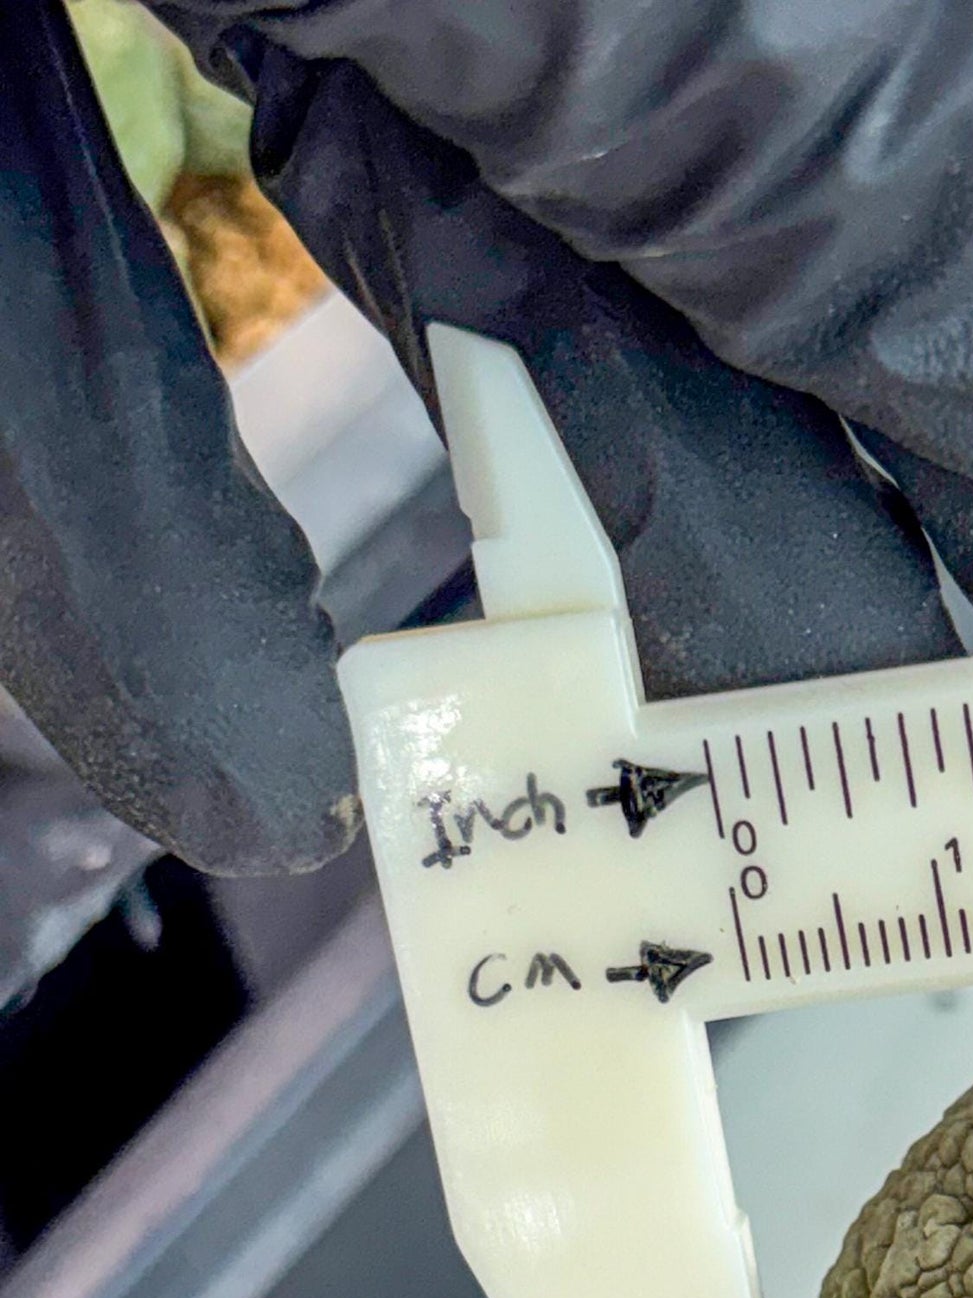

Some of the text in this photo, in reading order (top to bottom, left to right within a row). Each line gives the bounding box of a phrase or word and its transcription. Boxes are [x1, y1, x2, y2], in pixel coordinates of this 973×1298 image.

[732, 820, 757, 856] 0
[741, 866, 768, 900] 0
[944, 837, 962, 872] 1
